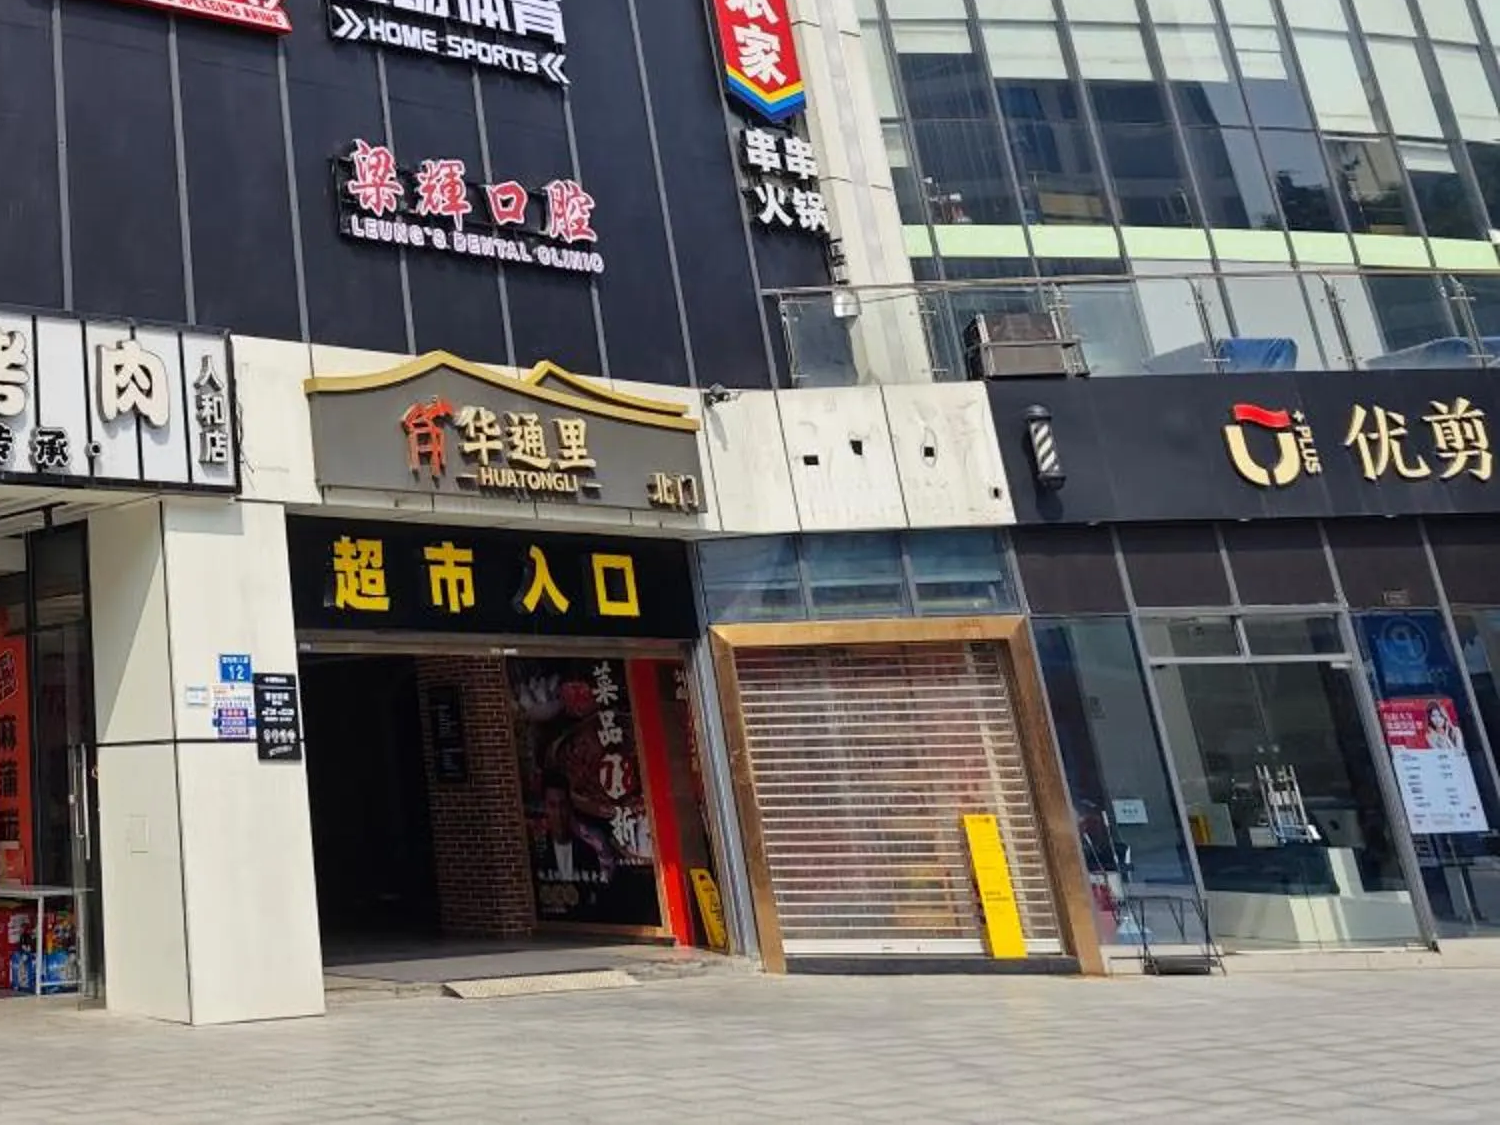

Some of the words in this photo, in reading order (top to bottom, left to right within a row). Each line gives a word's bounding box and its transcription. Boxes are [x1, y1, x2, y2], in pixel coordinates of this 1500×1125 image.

[368, 16, 438, 53] HOME
[447, 35, 539, 76] SPORTS
[744, 127, 819, 181] 串串
[753, 182, 829, 234] 火锅
[453, 230, 533, 263] DENTAL
[537, 245, 605, 274] CLINIC
[194, 354, 229, 465] 人和店
[455, 405, 597, 470] 华通里
[1343, 396, 1494, 483] 优剪
[479, 466, 579, 493] HUATONGLI
[650, 472, 699, 508] 北门
[332, 534, 641, 619] 超市入口
